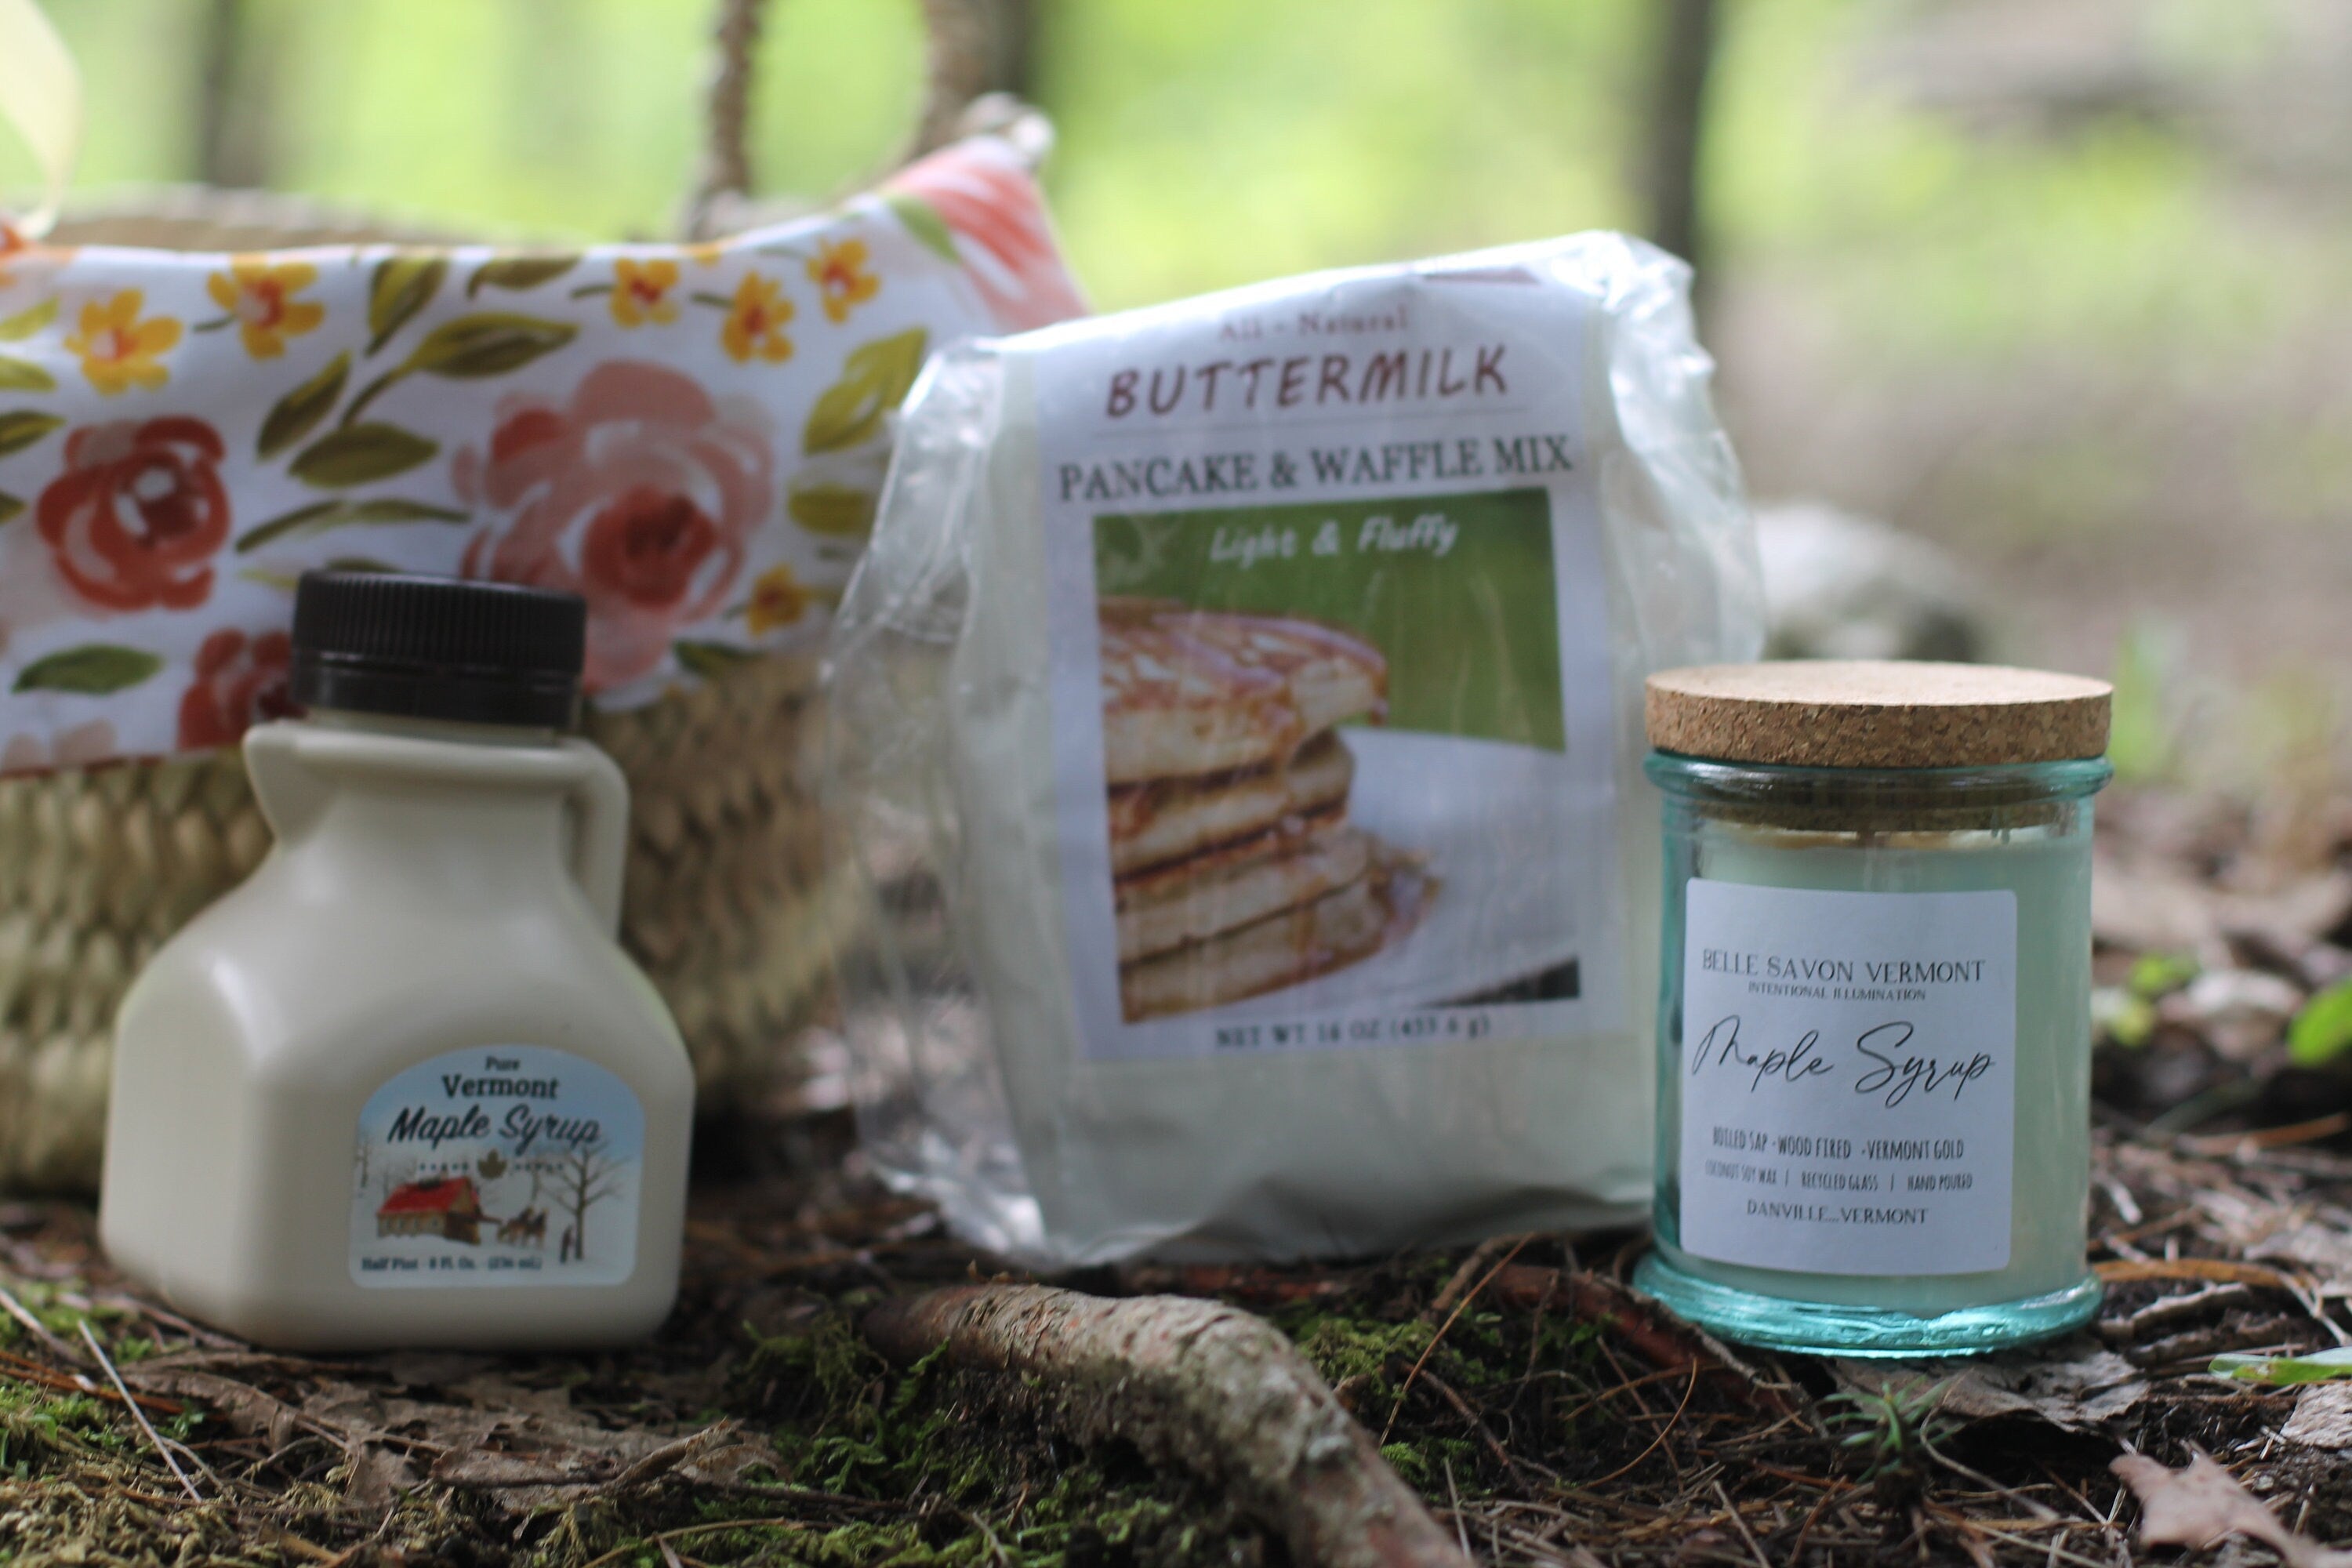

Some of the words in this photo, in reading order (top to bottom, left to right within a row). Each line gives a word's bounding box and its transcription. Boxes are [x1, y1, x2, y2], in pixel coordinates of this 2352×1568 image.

[1106, 345, 1507, 419] BUTTERMILK
[1059, 449, 1259, 503] PANCAKE
[1269, 452, 1298, 488] &
[1310, 441, 1483, 485] WAFFLE
[1492, 434, 1573, 474] MIX
[1210, 524, 1298, 570] Light
[1312, 519, 1338, 556] &
[1357, 513, 1457, 557] Fluffy
[1703, 948, 1759, 976] BELLE
[1766, 955, 1853, 983] SAVON
[1865, 959, 1987, 985] VERMONT
[1748, 980, 1827, 1000] INTENTIONAL
[1832, 986, 1926, 1002] ILLUMINATION
[485, 1055, 521, 1072] Pure
[1692, 1014, 1835, 1093] Maple
[1855, 1022, 1995, 1109] Syrup
[441, 1074, 561, 1099] Vermont
[387, 1104, 492, 1149] Maple
[499, 1103, 601, 1156] Syrup
[1749, 1130, 1768, 1153] SAP
[1815, 1137, 1851, 1160] FIRED
[1933, 1139, 1964, 1160] GOLD
[1801, 1170, 1846, 1191] RECYCLED
[1848, 1173, 1879, 1192] GLASS
[1907, 1174, 1936, 1192] HAND
